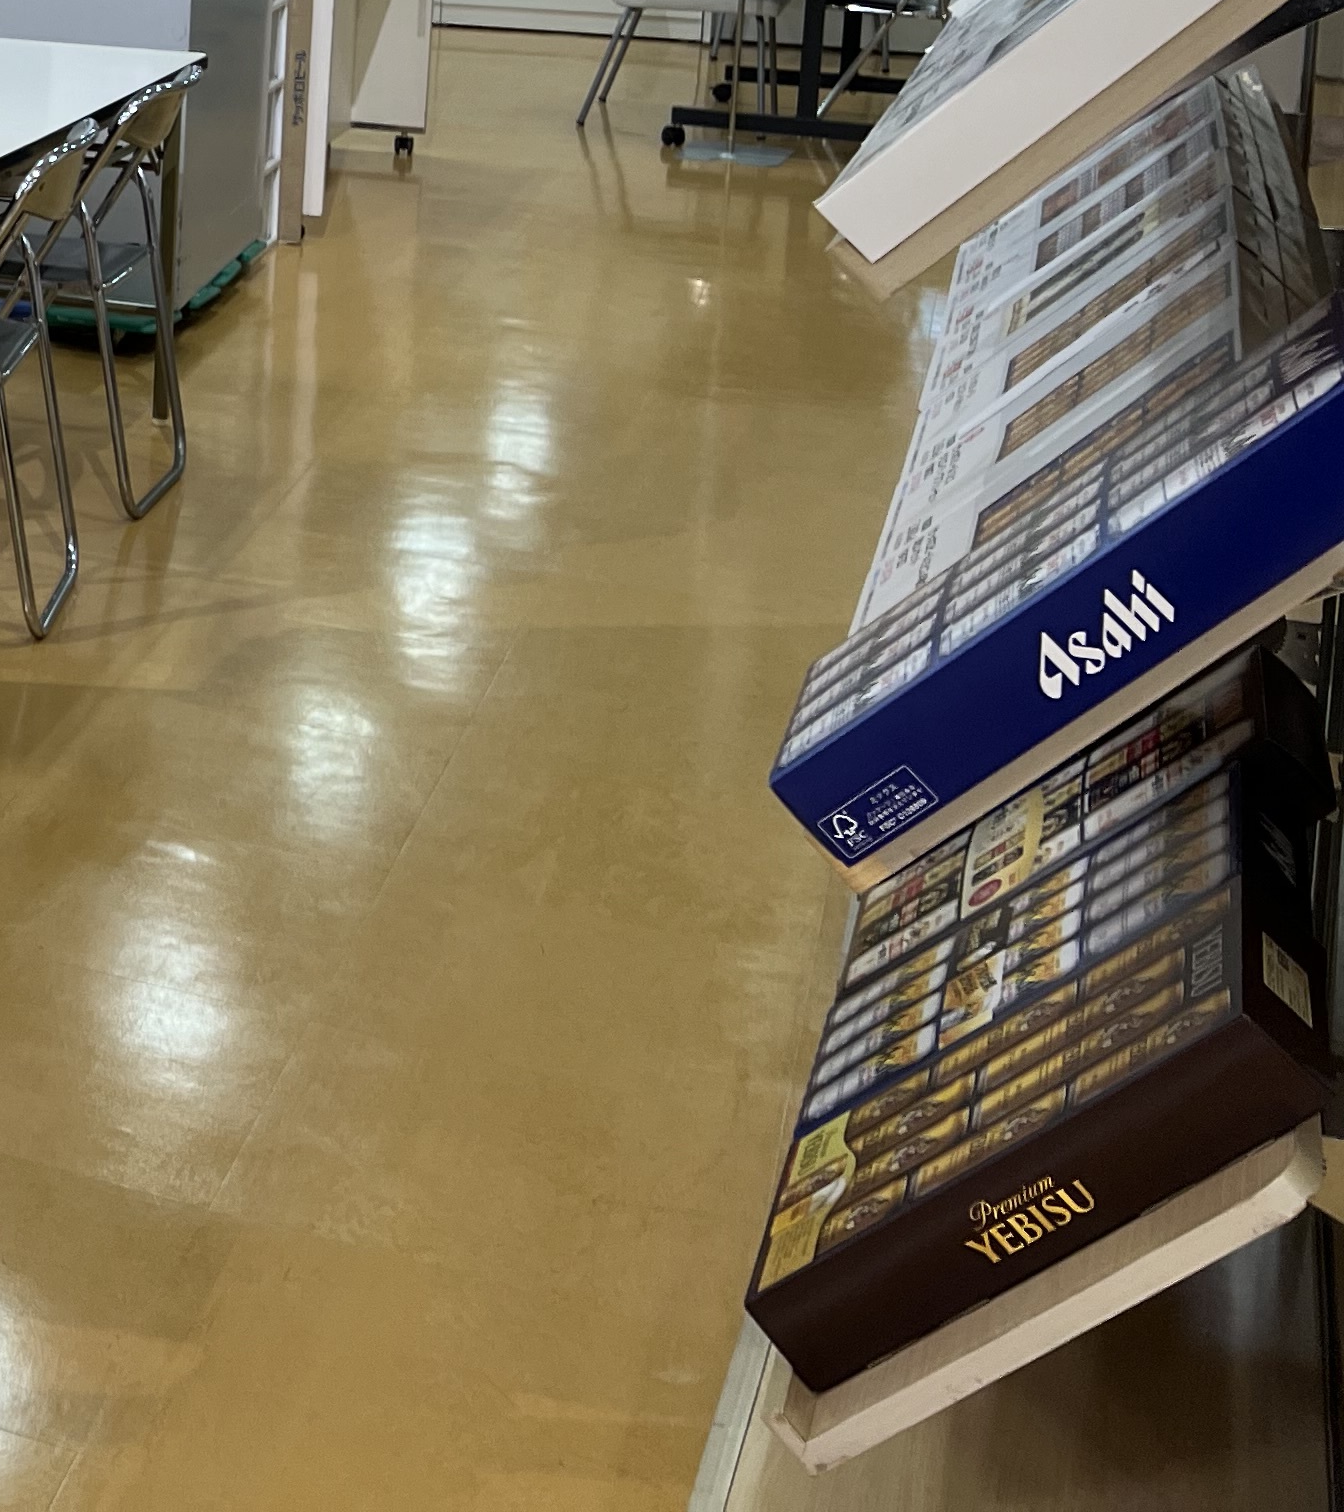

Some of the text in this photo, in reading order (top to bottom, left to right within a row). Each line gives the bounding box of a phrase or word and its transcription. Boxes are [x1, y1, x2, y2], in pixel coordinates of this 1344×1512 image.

[1038, 569, 1175, 699] Asahi
[964, 1179, 1095, 1264] YEBISU
[969, 1175, 1055, 1231] Premium
